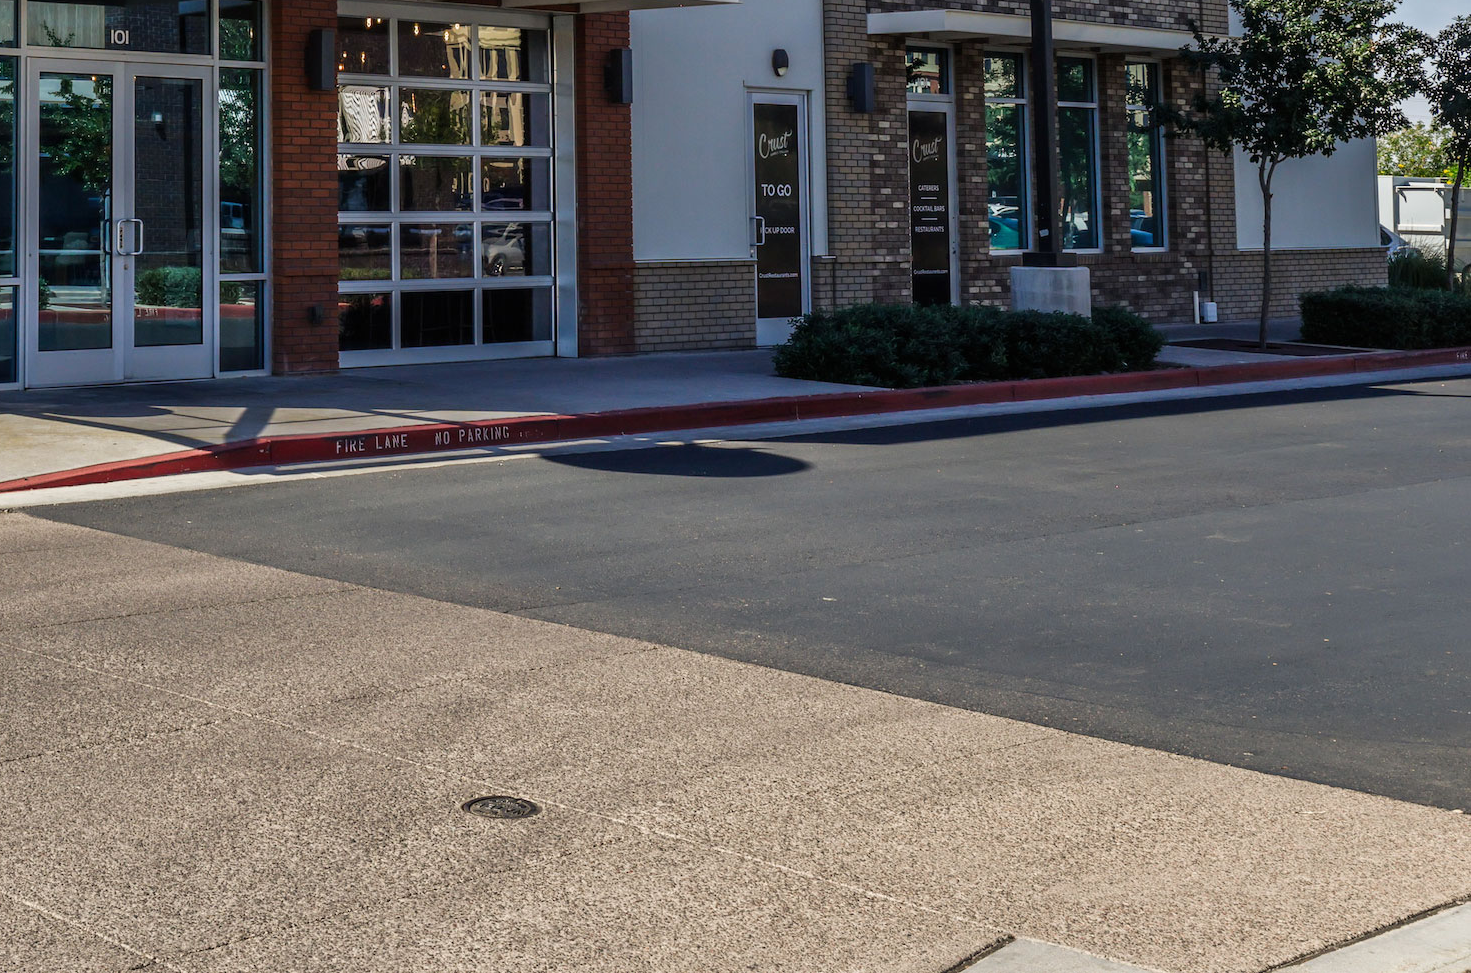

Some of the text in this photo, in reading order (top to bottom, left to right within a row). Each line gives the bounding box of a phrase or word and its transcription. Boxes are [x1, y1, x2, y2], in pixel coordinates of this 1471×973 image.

[110, 29, 129, 45] 101
[759, 129, 793, 159] Crust
[912, 137, 942, 163] Crust
[761, 184, 792, 197] TO GO
[760, 226, 795, 234] CK UP DOOR
[914, 225, 945, 233] RESTAURANTS
[336, 426, 510, 454] FIRE LANE NO PARKING
